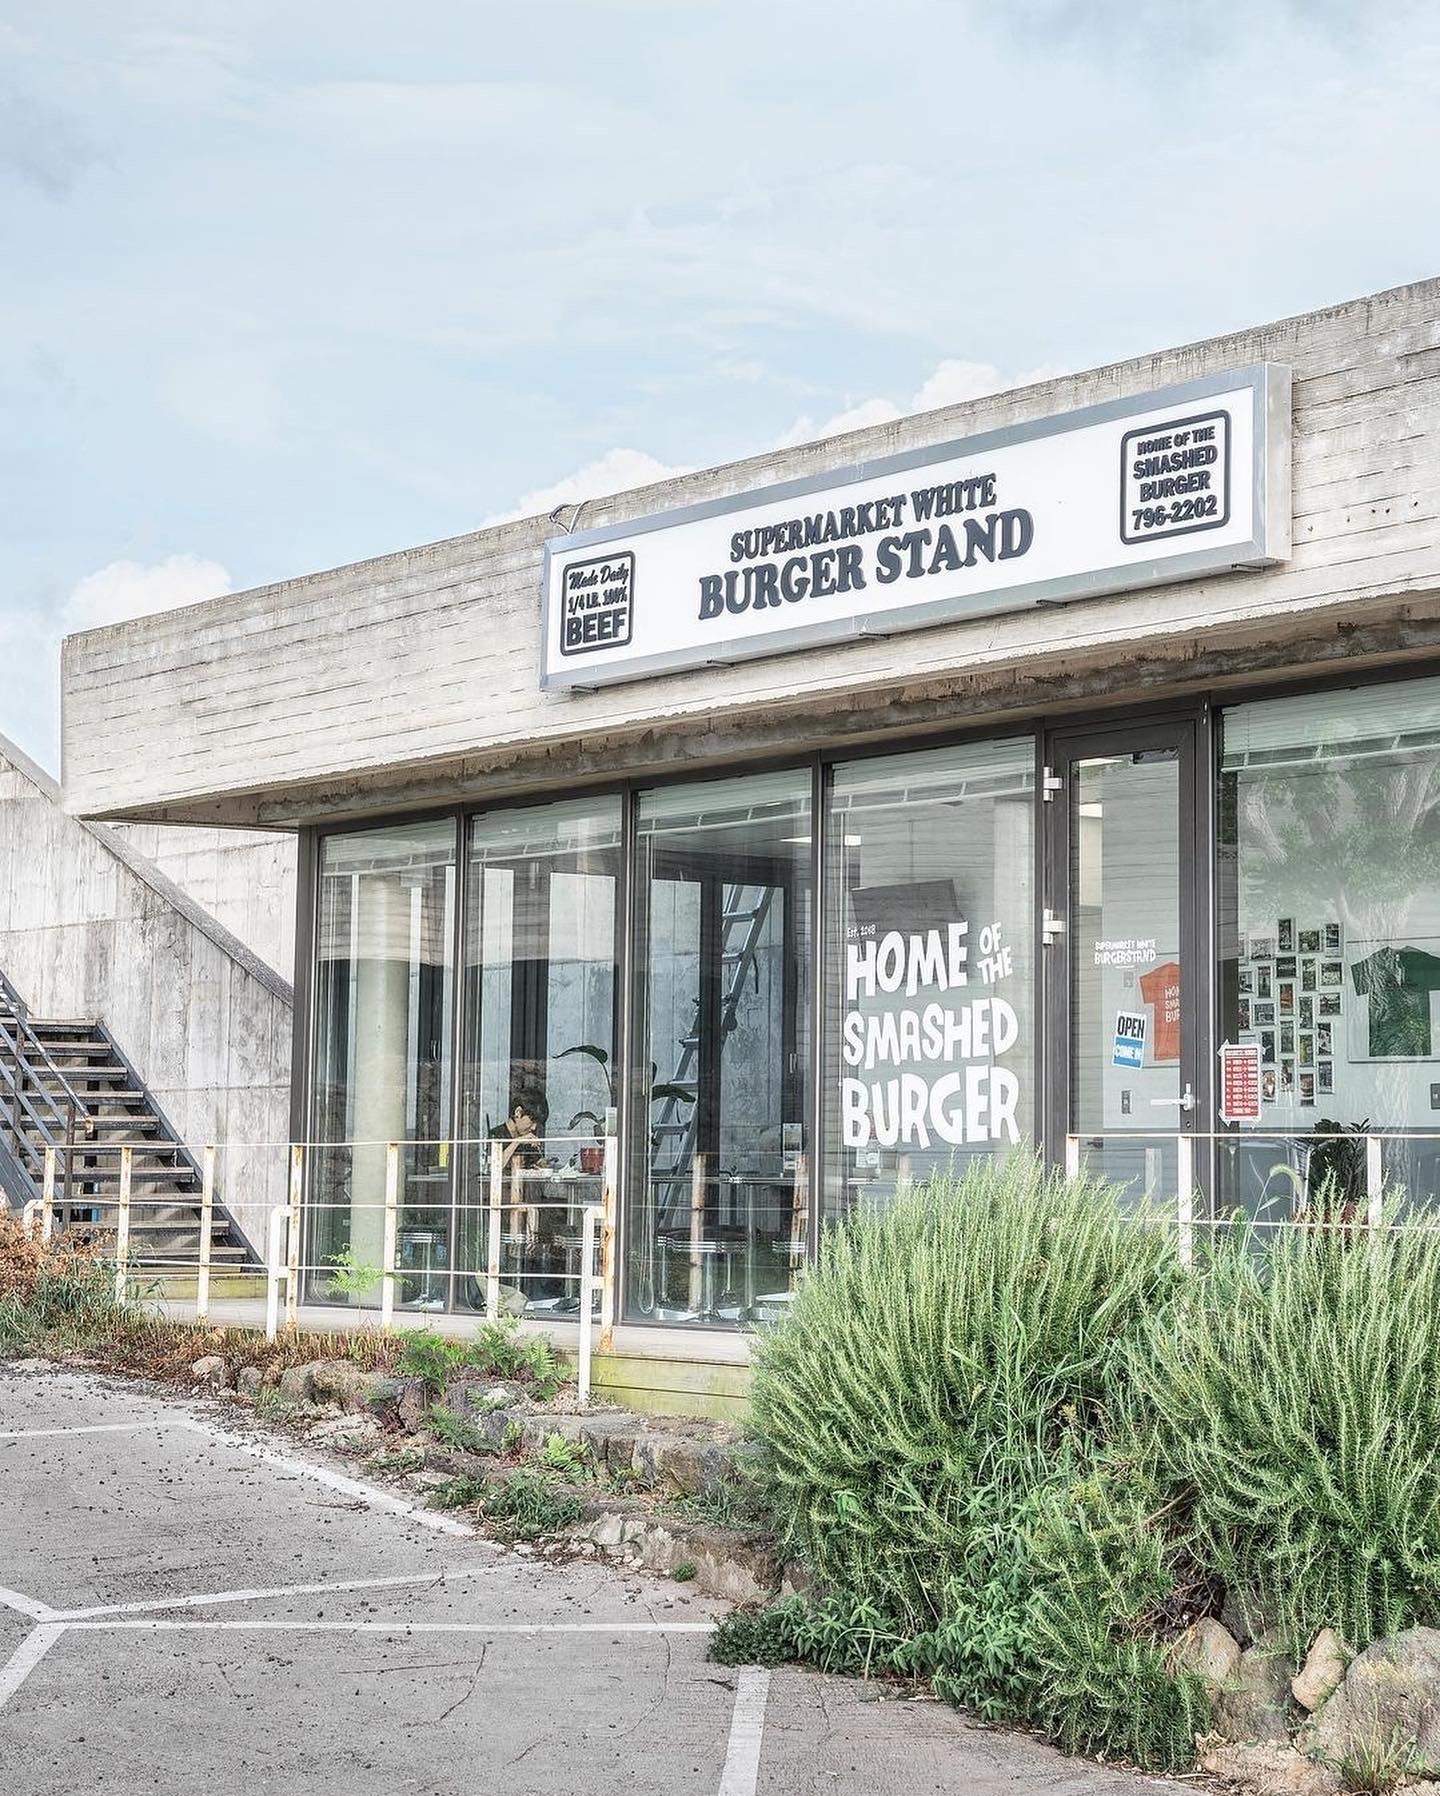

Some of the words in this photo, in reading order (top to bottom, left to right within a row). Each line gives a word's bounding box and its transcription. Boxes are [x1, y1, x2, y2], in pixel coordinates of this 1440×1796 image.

[1137, 436, 1172, 455] HOME
[1173, 430, 1190, 447] OF
[1192, 425, 1216, 443] THE
[1133, 444, 1218, 480] SMASHED
[1139, 470, 1211, 503] BURGER
[730, 494, 907, 562] SUPERMARKET
[911, 473, 998, 522] WHITE
[1132, 494, 1218, 531] 796-2202
[568, 569, 598, 590] Made
[600, 563, 629, 585] Daily
[698, 544, 866, 621] BURGER
[876, 508, 1035, 584] STAND
[568, 594, 585, 615] 1/4
[586, 592, 601, 609] LB.
[602, 586, 627, 606] 100%
[566, 607, 627, 646] BEEF
[979, 922, 1002, 955] OF
[847, 921, 969, 1000] HOME
[977, 946, 1013, 985] THE
[1094, 949, 1156, 965] BURGERSTAND
[843, 997, 1019, 1070] SMASHED
[1117, 1016, 1145, 1039] OPEN
[842, 1065, 1021, 1149] BURGER
